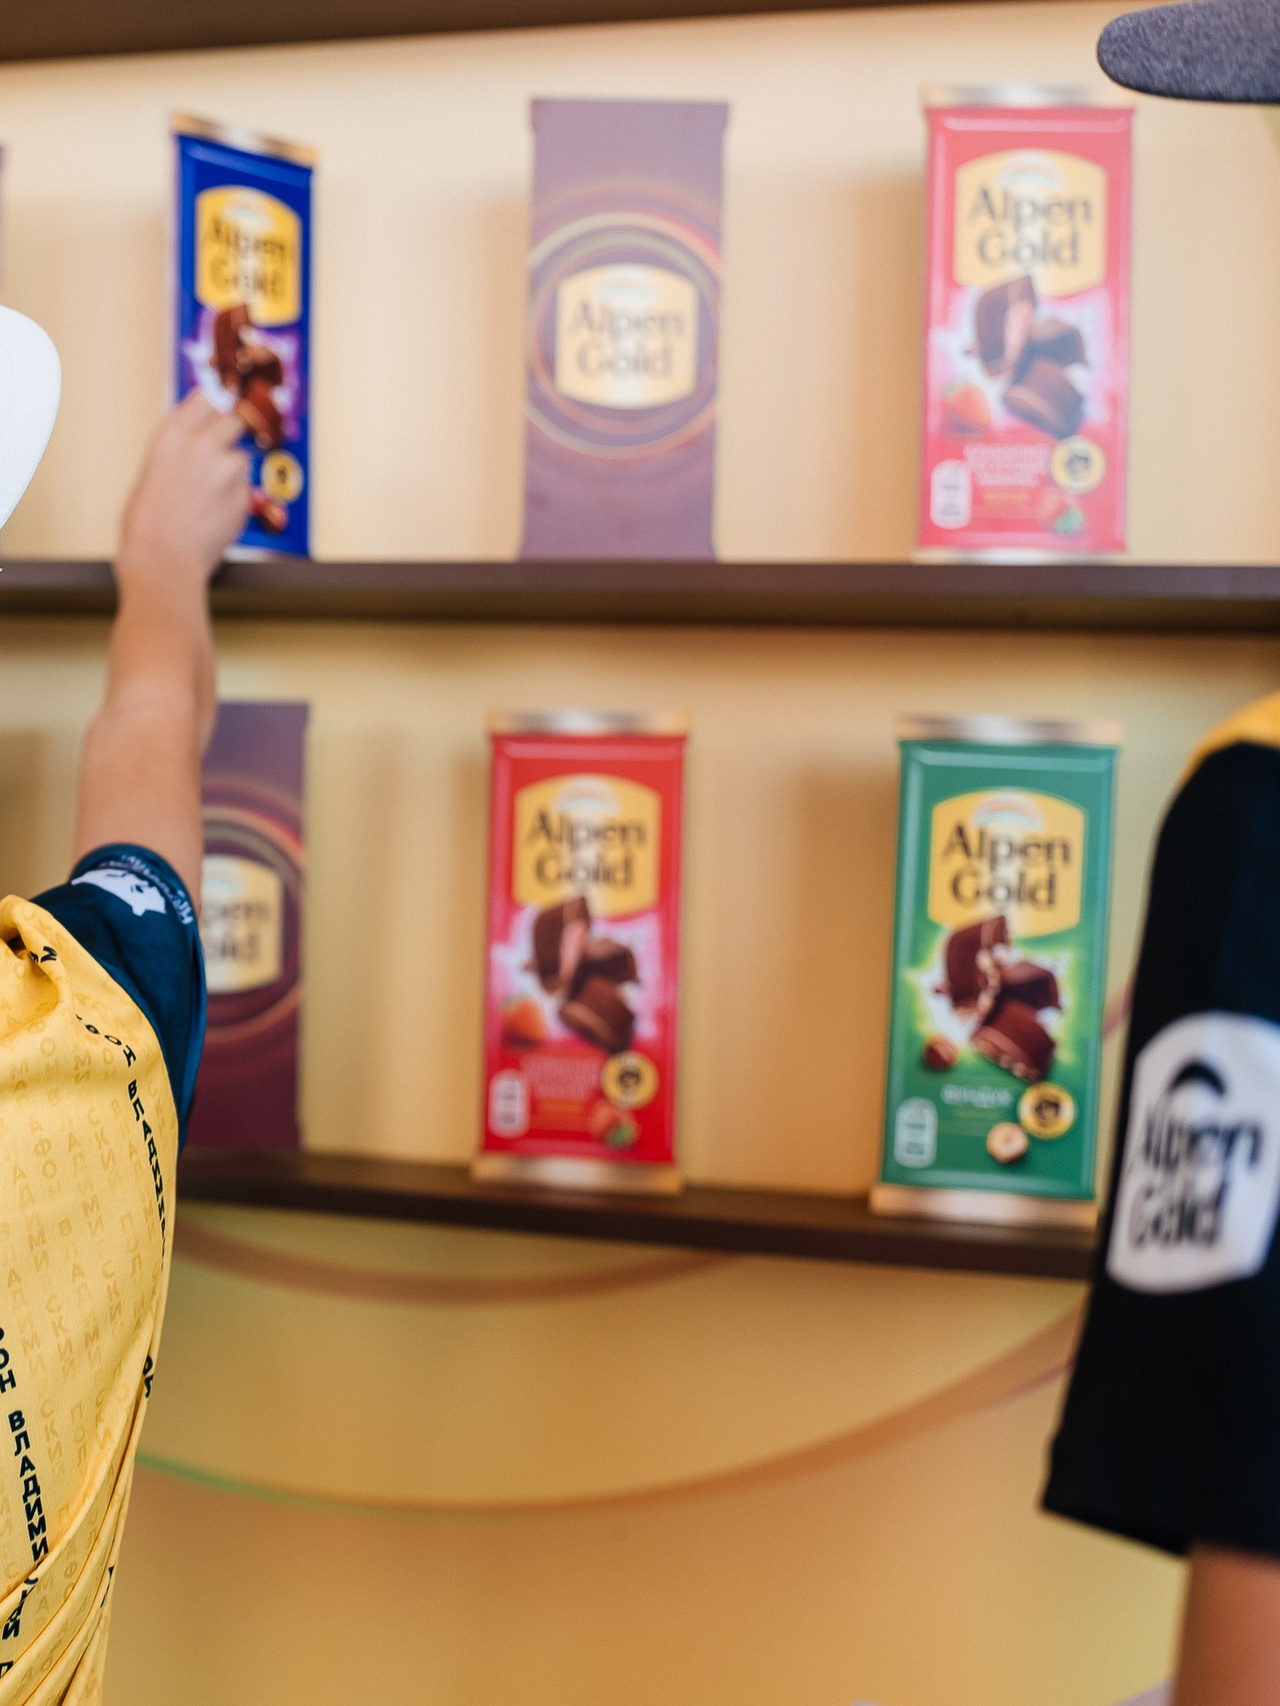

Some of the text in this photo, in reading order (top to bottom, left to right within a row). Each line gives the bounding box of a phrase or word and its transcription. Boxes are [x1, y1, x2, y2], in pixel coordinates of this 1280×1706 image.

[966, 186, 1092, 232] Alpen
[976, 231, 1079, 268] Gold
[570, 299, 686, 342] Alpen
[577, 339, 673, 380] Gold
[526, 810, 648, 850] Alpen
[941, 822, 1073, 871] Alpen
[533, 850, 634, 888] Gold
[949, 868, 1058, 909] Gold
